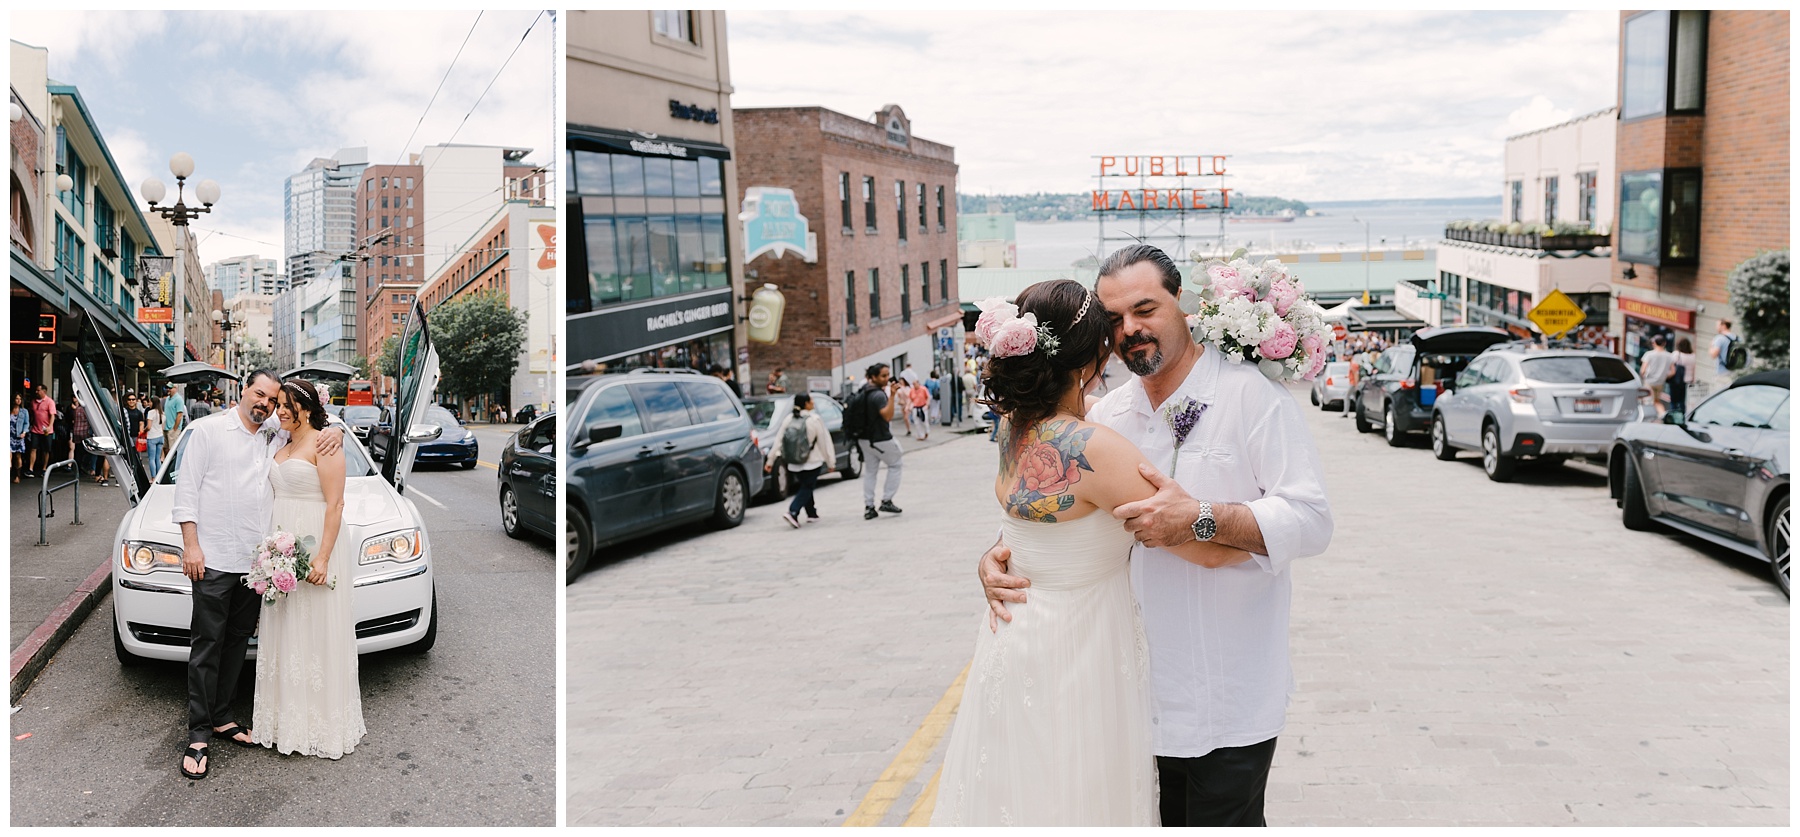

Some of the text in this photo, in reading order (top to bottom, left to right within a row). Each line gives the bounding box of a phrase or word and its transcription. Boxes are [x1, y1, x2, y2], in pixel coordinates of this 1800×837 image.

[1101, 155, 1227, 176] PUBLIC
[1091, 188, 1234, 211] MARKET
[646, 301, 730, 332] RACHEL'S GINGER BEER
[1536, 309, 1577, 317] RESIDENTIAL
[1544, 318, 1569, 326] STREET
[1643, 304, 1679, 323] CAMPAGNE
